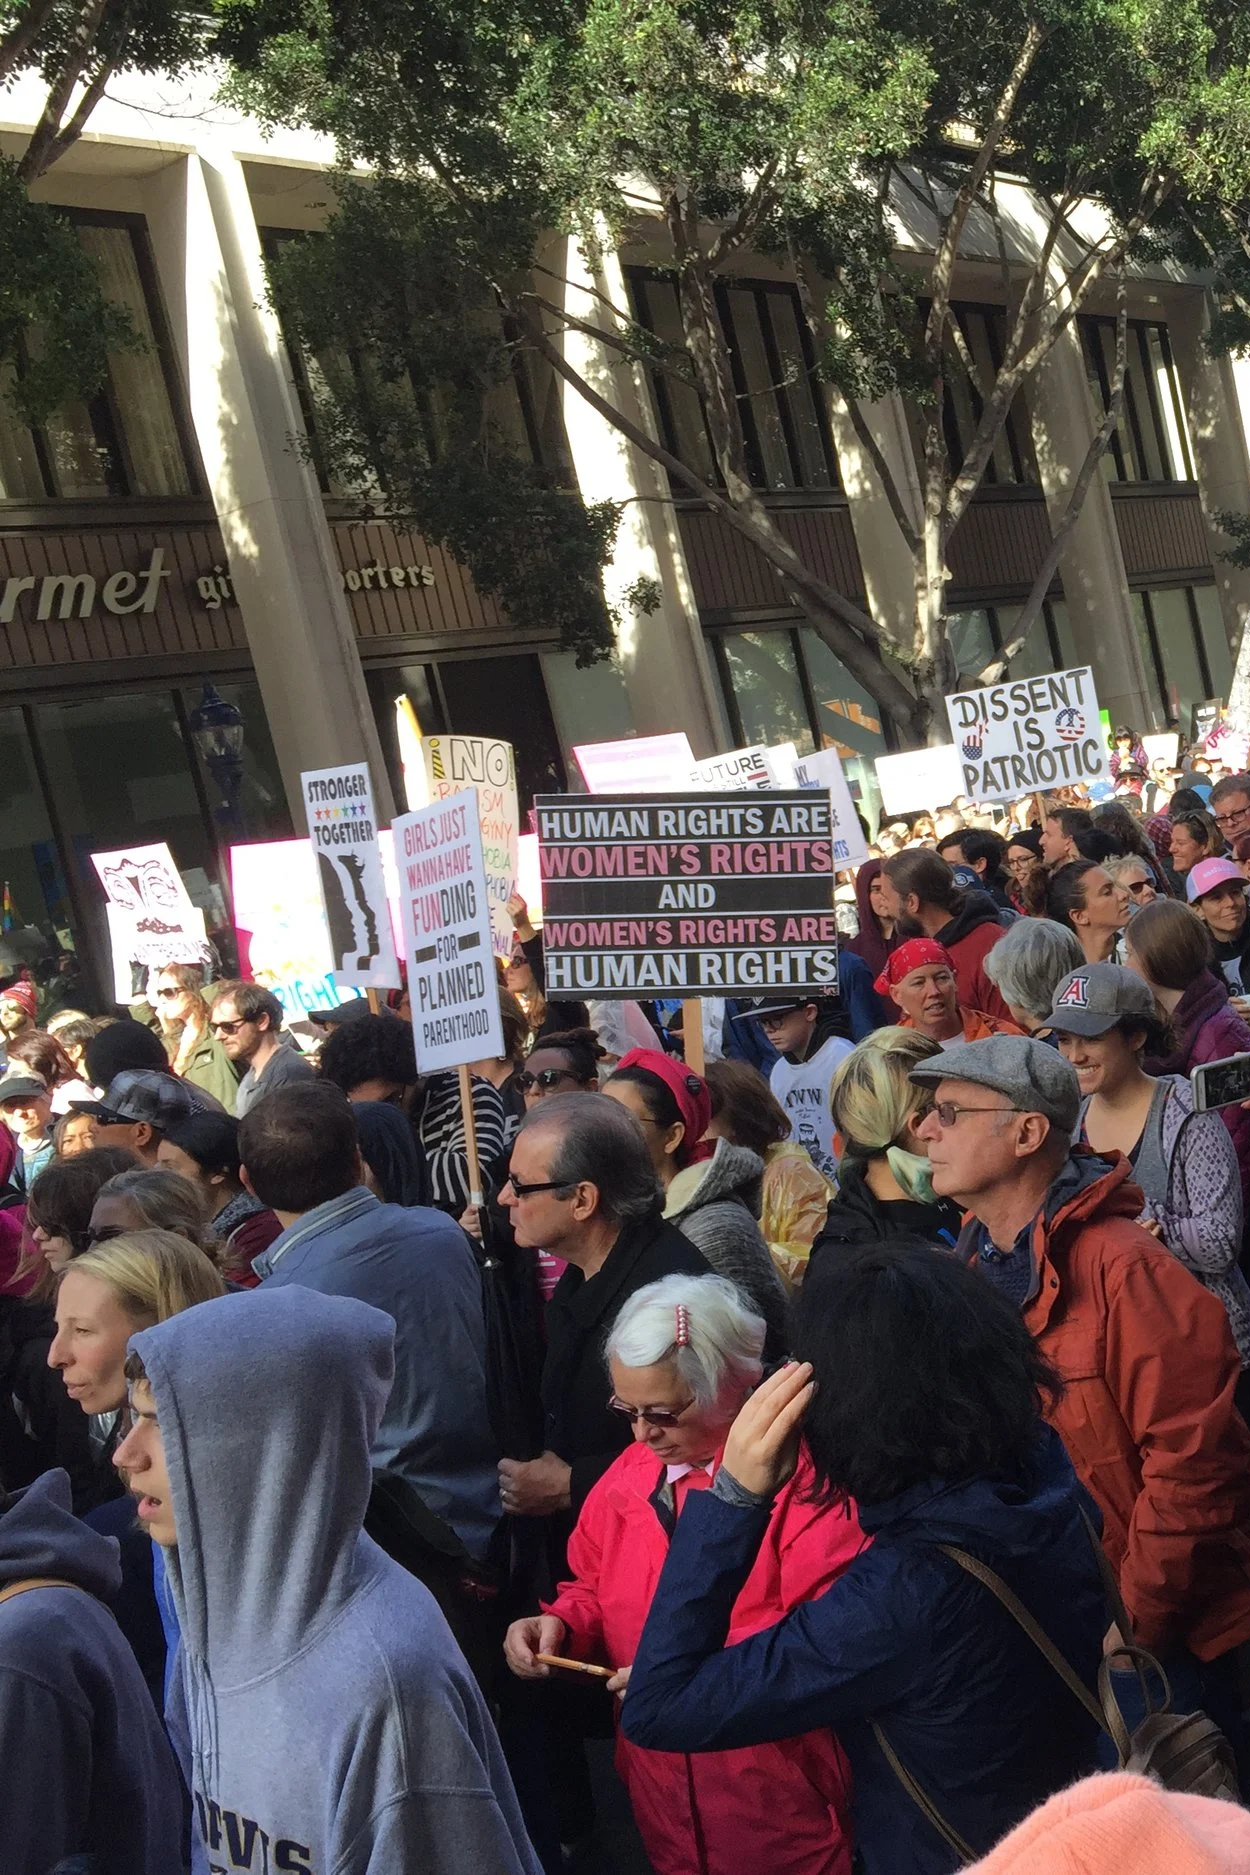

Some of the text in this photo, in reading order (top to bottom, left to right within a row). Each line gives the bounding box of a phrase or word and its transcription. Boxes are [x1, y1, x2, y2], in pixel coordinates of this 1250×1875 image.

[337, 560, 435, 593] orters
[952, 668, 1088, 729] DISSENT
[1013, 717, 1045, 752] IS
[962, 738, 1102, 797] PATRIOTIC
[308, 774, 367, 803] STRONGER
[313, 820, 374, 846] TOGETHER
[404, 804, 467, 857] GIRLS JUST
[541, 810, 650, 839] HUMAN
[658, 807, 765, 836] RIGHTS
[770, 806, 829, 835] ARE
[406, 843, 473, 892] WANNA HAVE
[542, 841, 832, 877] WOMEN'S RIGHTS
[411, 879, 477, 937] FUNDING
[658, 883, 716, 909] AND
[437, 933, 458, 964] FOR
[545, 916, 836, 948] WOMEN'S RIGHTS ARE
[549, 950, 837, 988] HUMAN RIGHTS
[418, 961, 485, 1013] PLANNED
[1056, 975, 1091, 1009] A
[423, 1008, 490, 1048] PARENTHOOD
